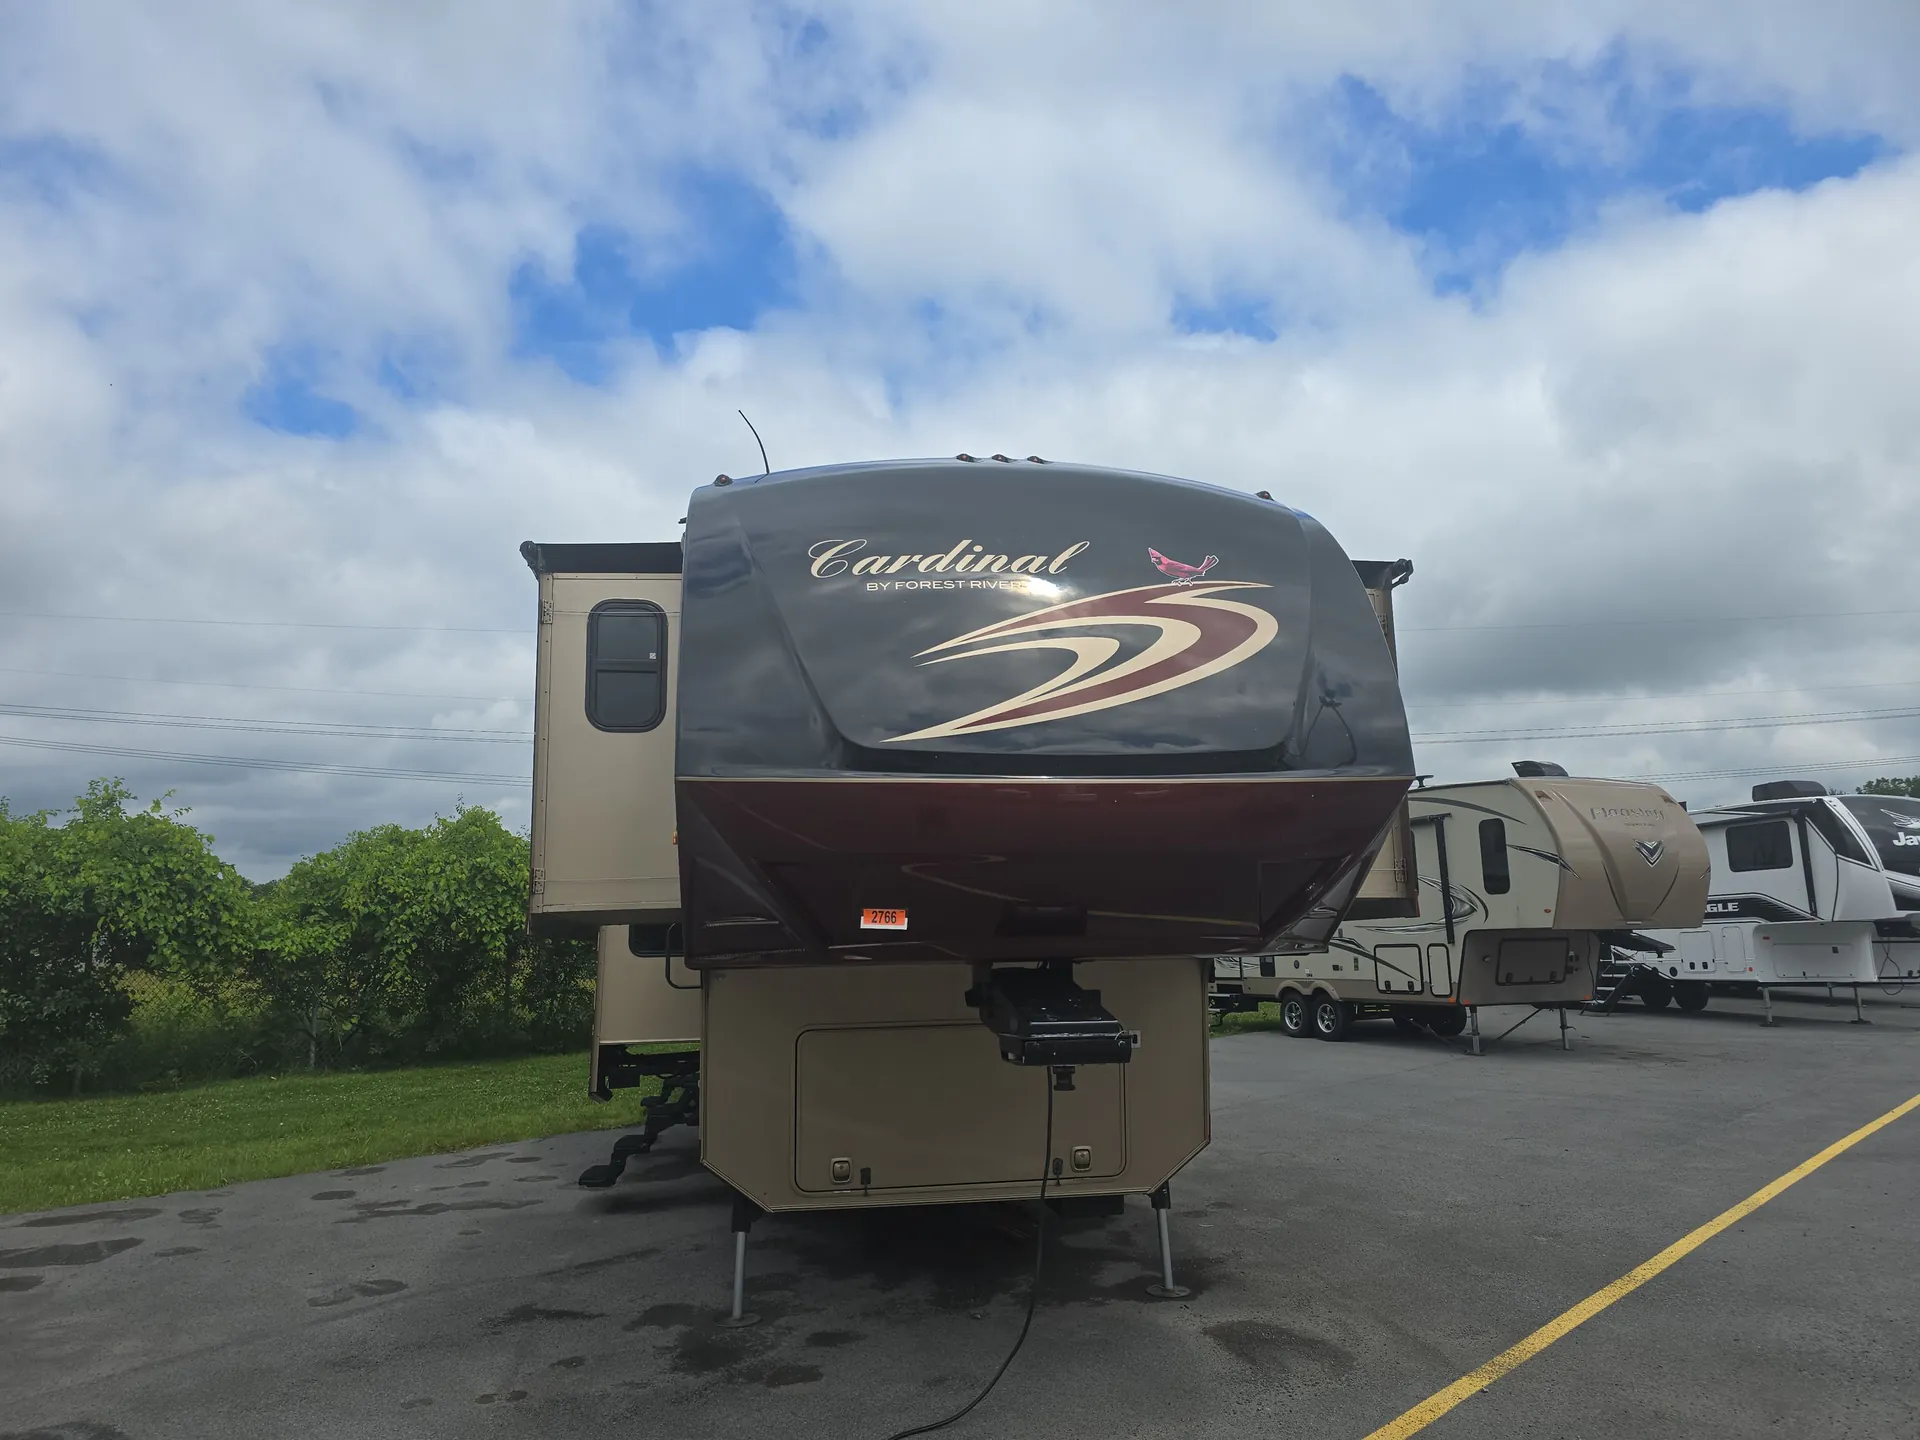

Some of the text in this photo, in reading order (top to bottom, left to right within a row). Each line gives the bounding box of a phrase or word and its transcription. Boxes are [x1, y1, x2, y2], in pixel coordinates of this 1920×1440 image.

[808, 538, 1090, 579] Cardinal
[866, 580, 1021, 591] BY FOREST RIVER
[871, 910, 897, 924] 2766
